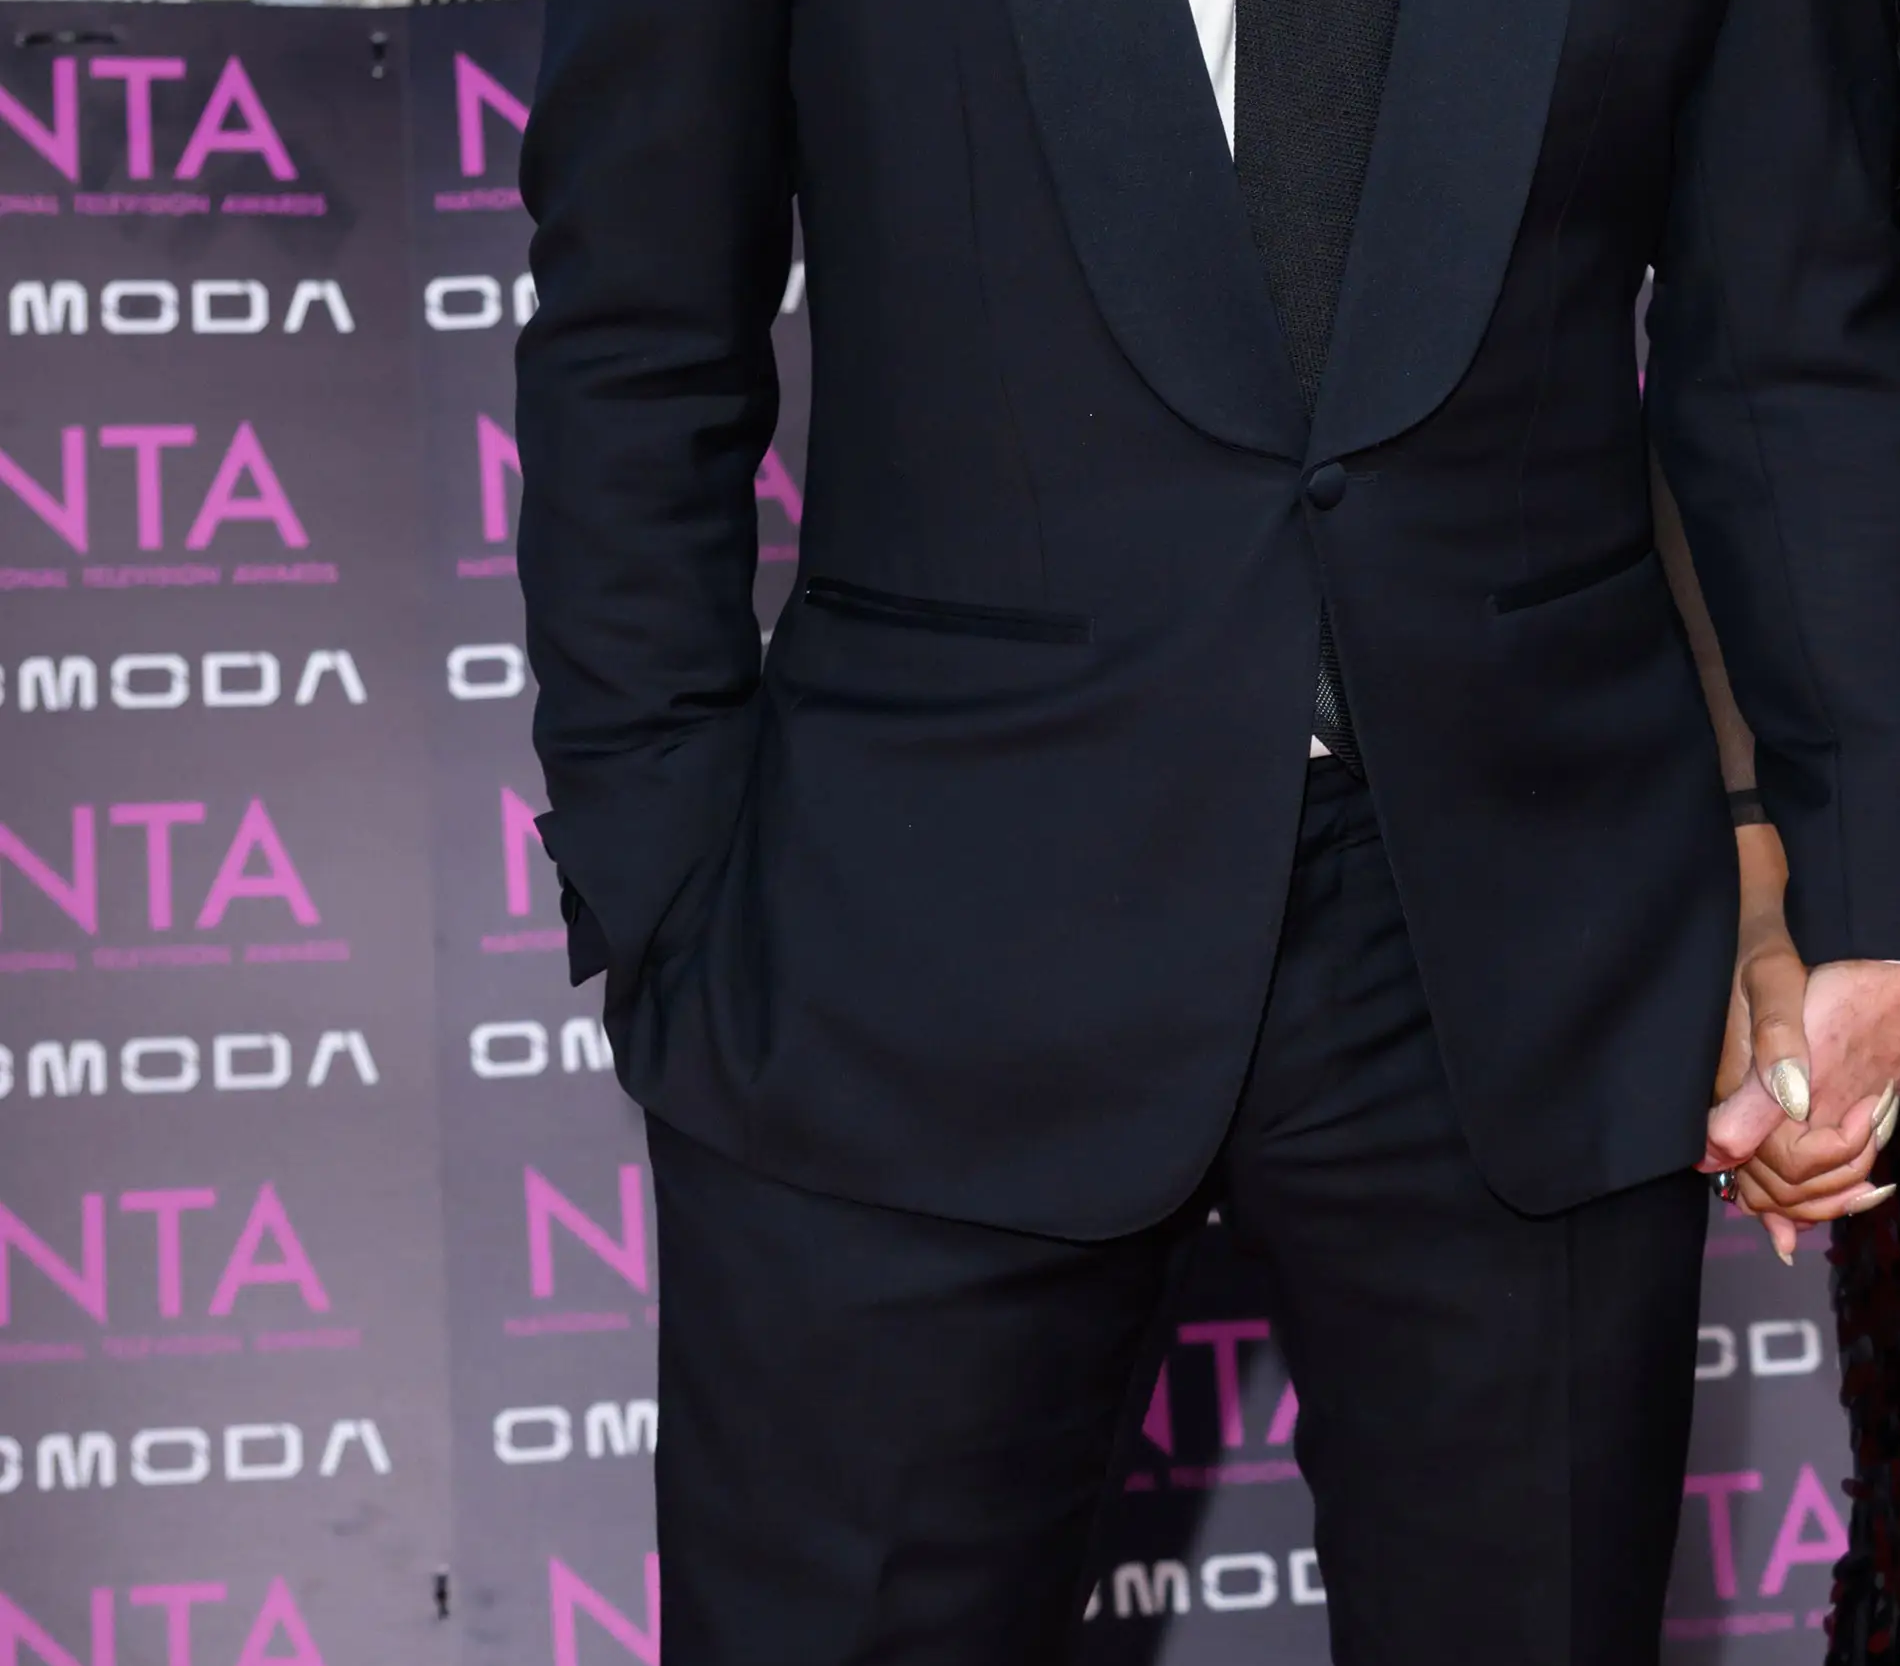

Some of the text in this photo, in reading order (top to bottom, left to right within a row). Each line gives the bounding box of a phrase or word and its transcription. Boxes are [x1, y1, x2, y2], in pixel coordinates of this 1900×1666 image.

[0, 54, 299, 183] NTA
[8, 279, 356, 335] MODA
[0, 420, 310, 555] NTA
[0, 649, 368, 712] MODA
[0, 794, 322, 936] NTA
[0, 1028, 380, 1098] MODA
[0, 1181, 332, 1328] NTA
[1683, 1462, 1850, 1600] TA
